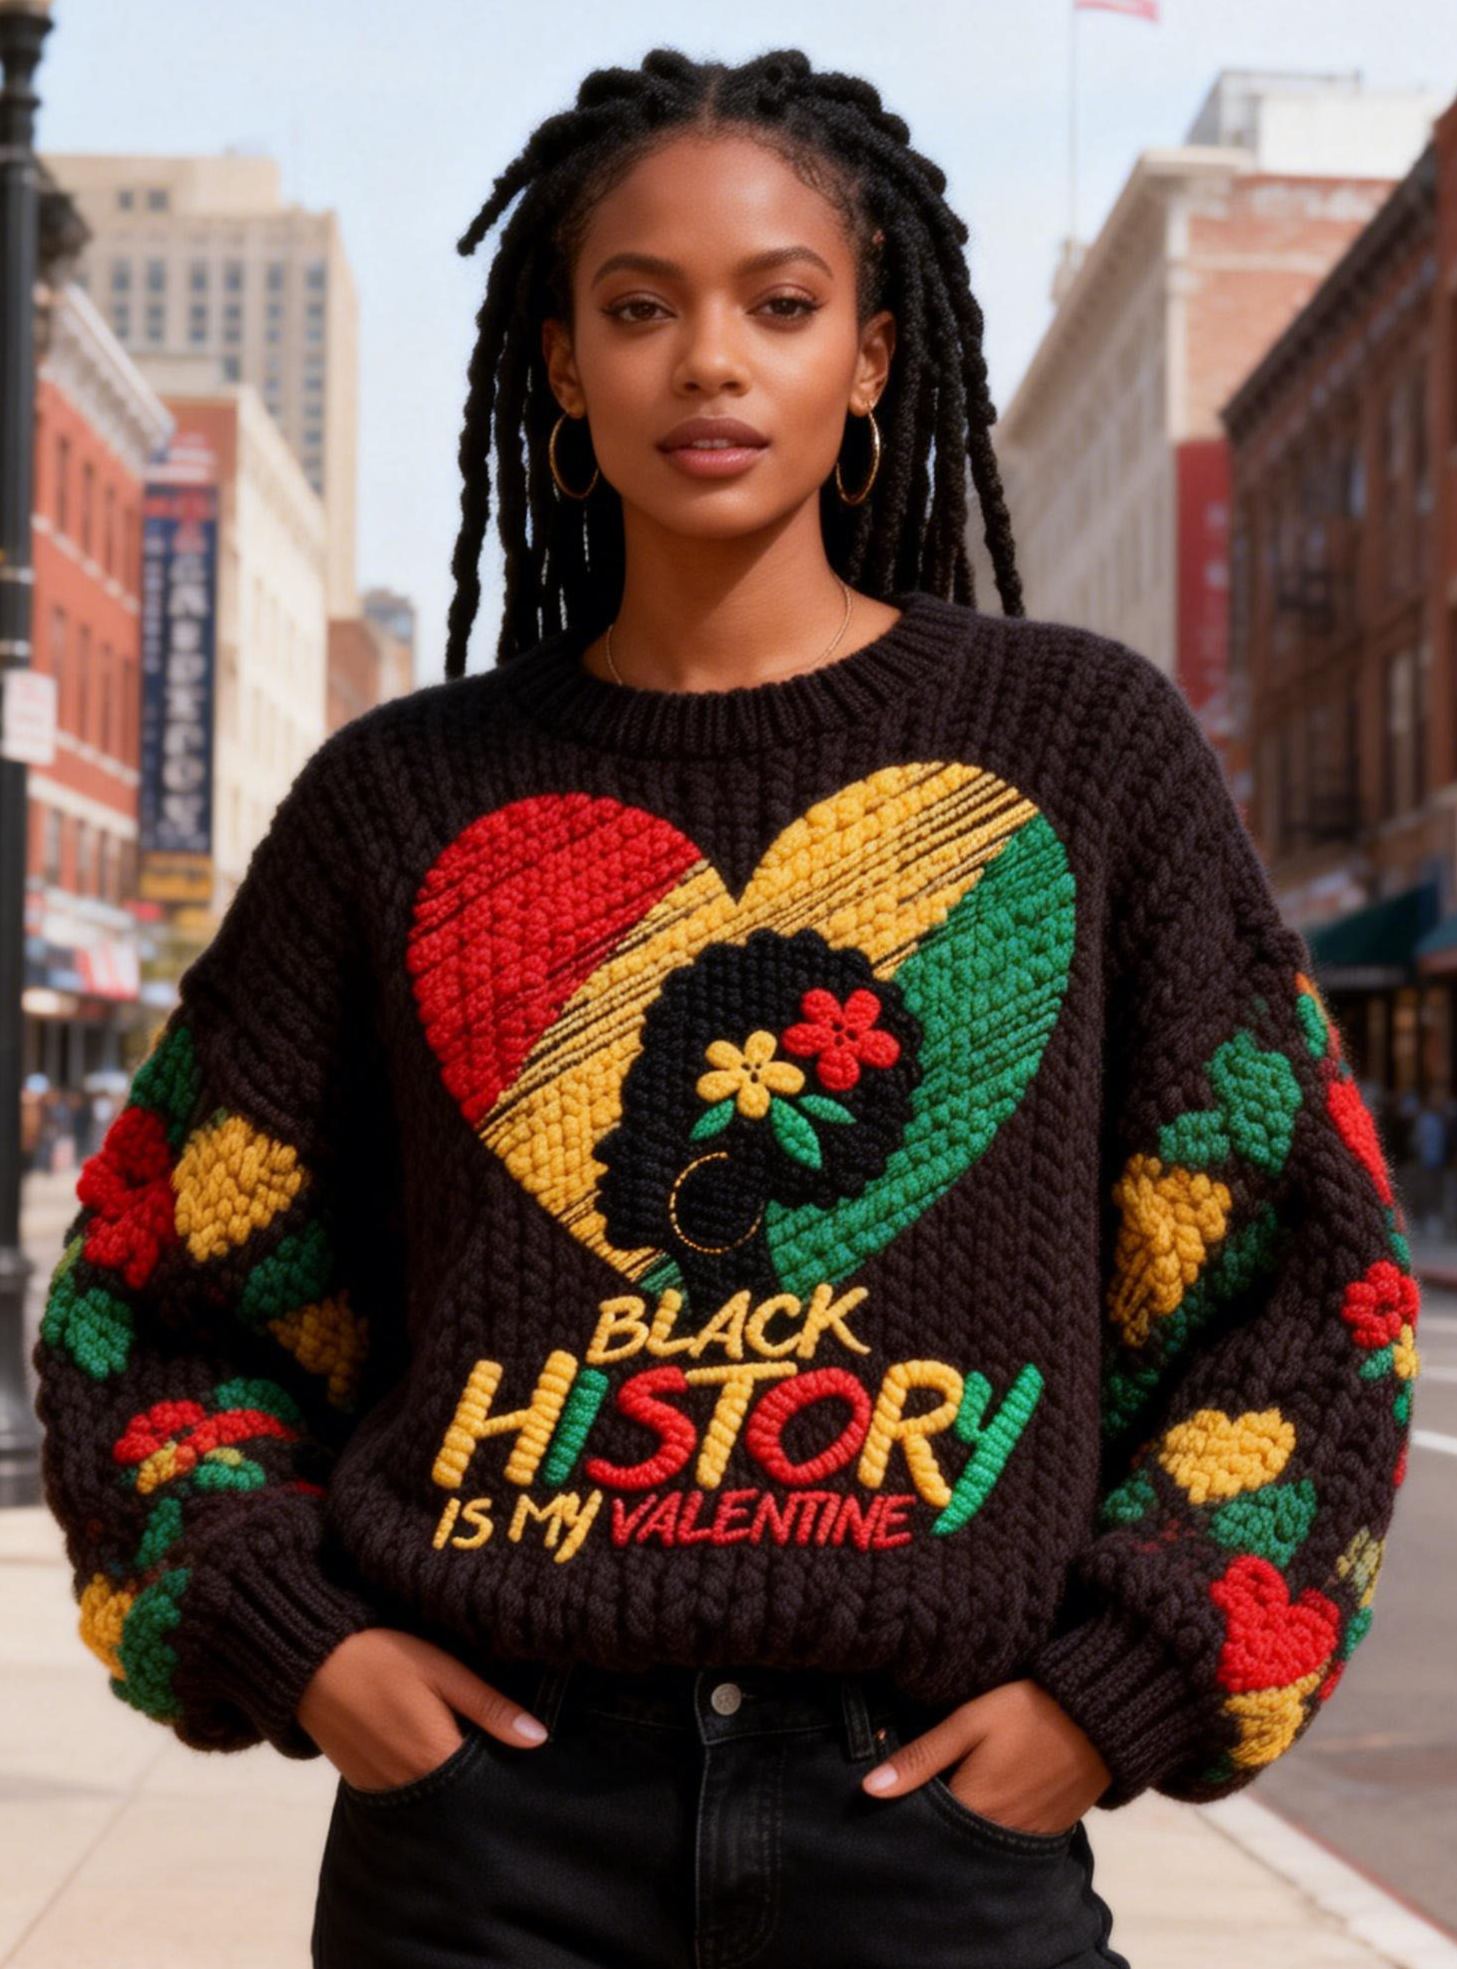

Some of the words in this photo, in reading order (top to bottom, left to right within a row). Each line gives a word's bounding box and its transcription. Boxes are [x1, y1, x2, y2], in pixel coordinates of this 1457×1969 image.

[586, 1283, 872, 1364] BLACK
[432, 1349, 1045, 1537] HISTORY
[432, 1497, 494, 1549] IS
[507, 1489, 603, 1564] MY
[611, 1488, 917, 1551] VALENTINE
